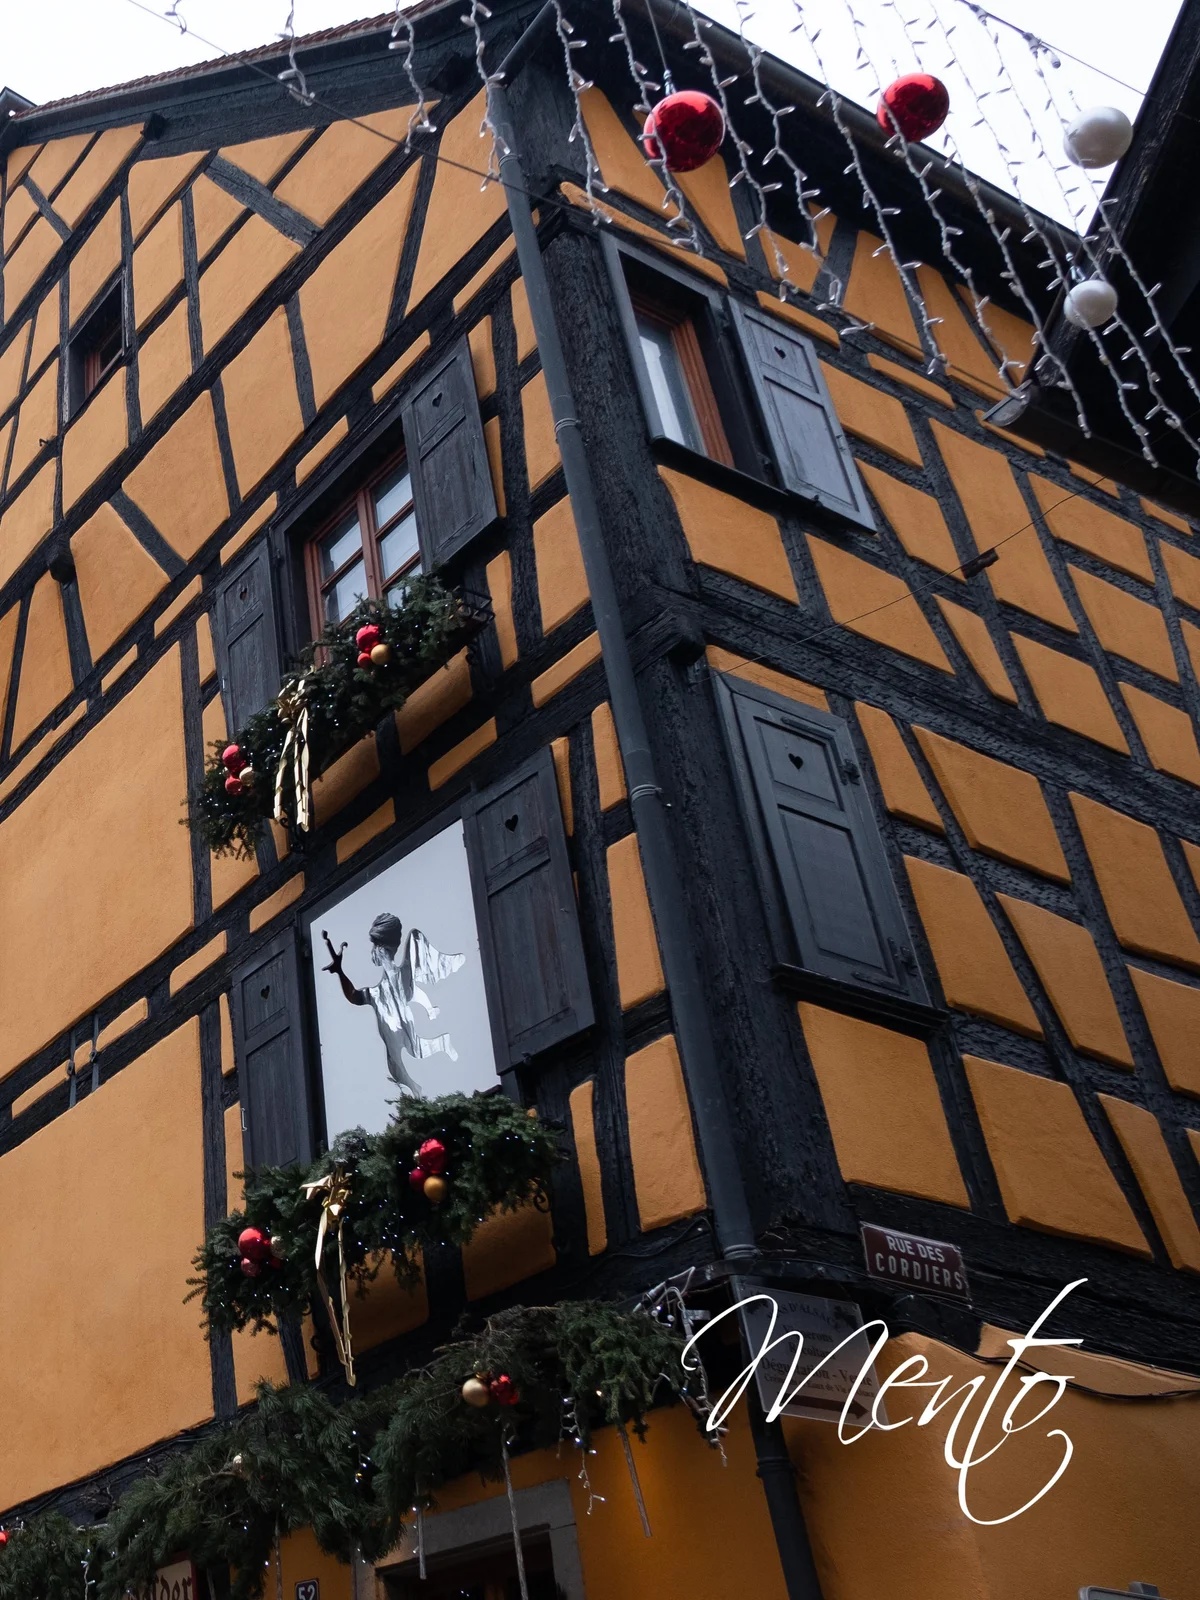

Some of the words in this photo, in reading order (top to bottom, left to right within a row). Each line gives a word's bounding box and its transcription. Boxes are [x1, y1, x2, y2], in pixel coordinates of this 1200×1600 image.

[886, 1235, 915, 1256] RUE
[916, 1243, 945, 1263] DES
[875, 1252, 963, 1290] CORDIERS
[761, 1356, 830, 1380] Dégutation
